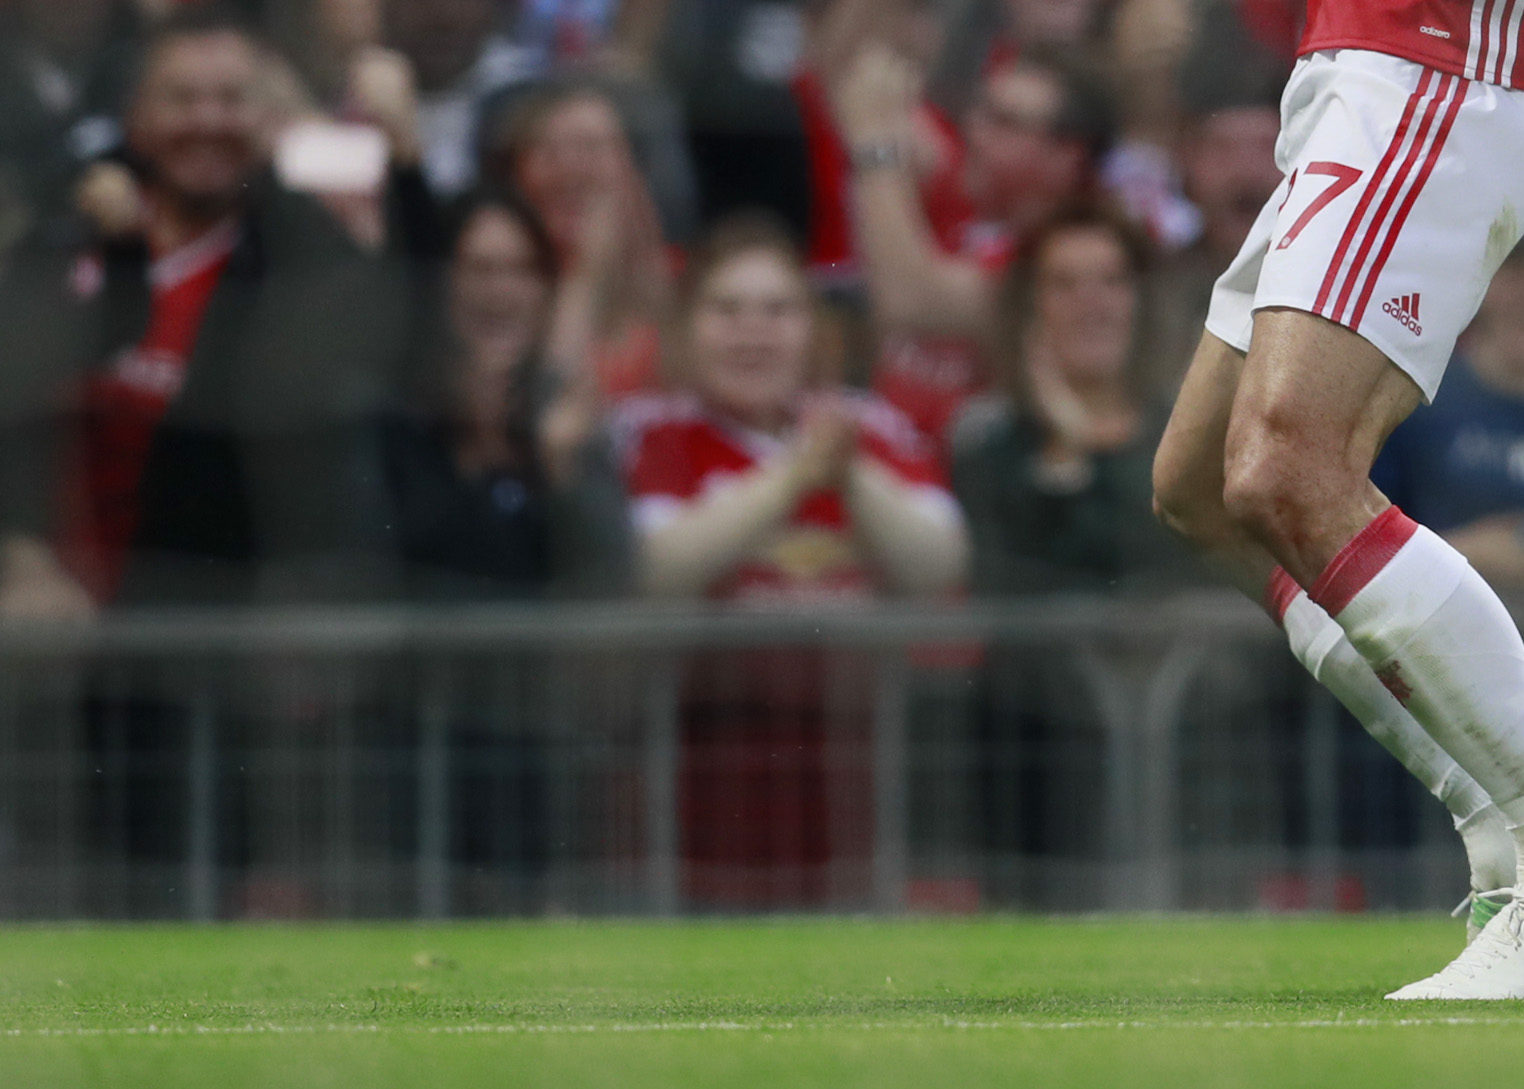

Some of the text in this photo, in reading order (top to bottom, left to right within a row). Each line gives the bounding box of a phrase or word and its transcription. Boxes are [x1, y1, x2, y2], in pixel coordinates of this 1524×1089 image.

[1419, 25, 1451, 39] adizero
[1265, 161, 1364, 252] 7
[1381, 301, 1423, 337] adidas
